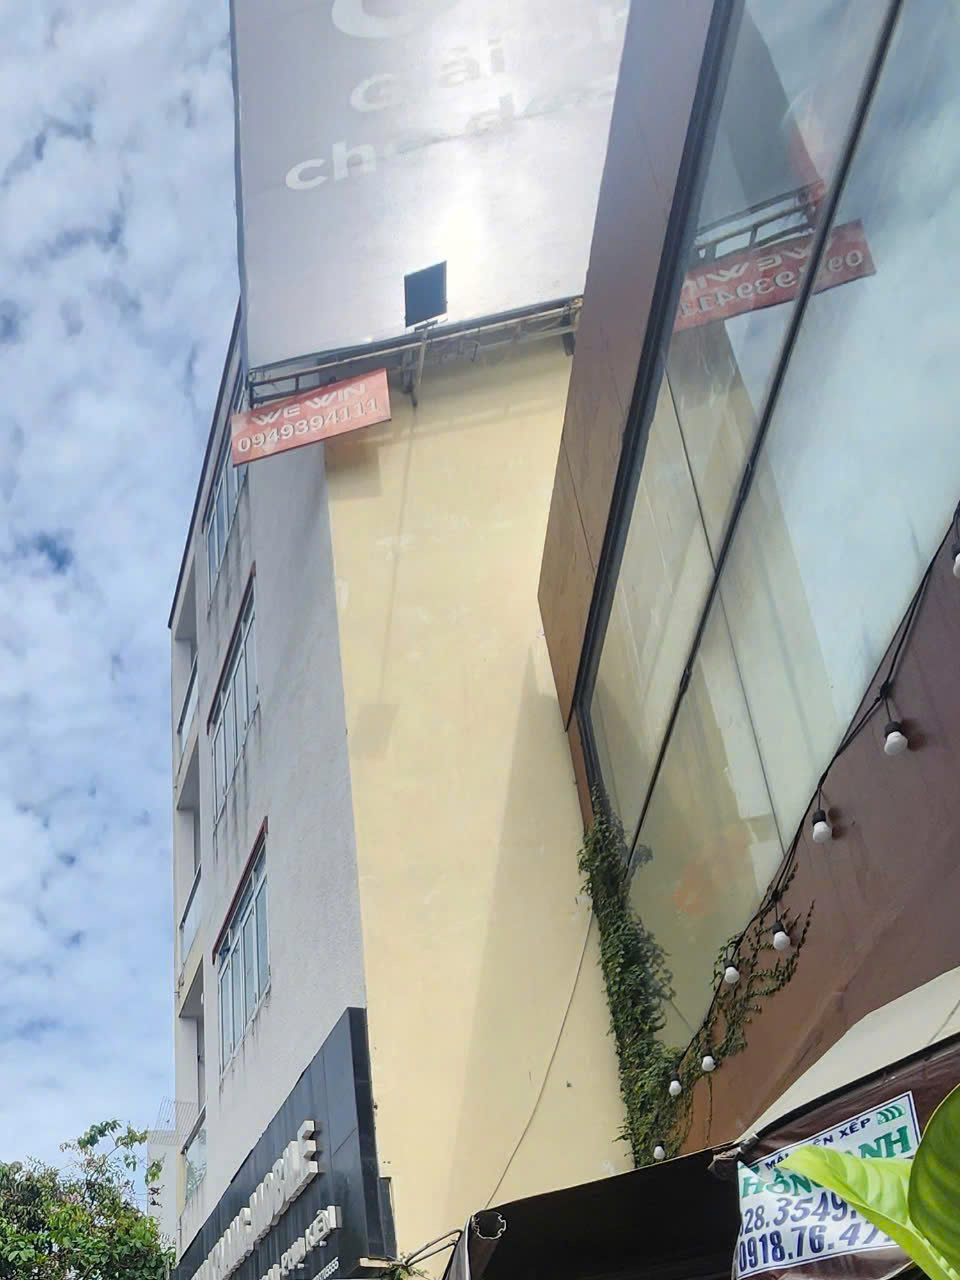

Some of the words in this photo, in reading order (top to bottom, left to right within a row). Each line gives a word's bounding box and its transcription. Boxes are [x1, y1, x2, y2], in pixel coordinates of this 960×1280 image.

[237, 399, 378, 452] 0949394111
[251, 403, 302, 426] WE
[305, 383, 366, 409] WIN
[839, 1115, 872, 1139] XẾP
